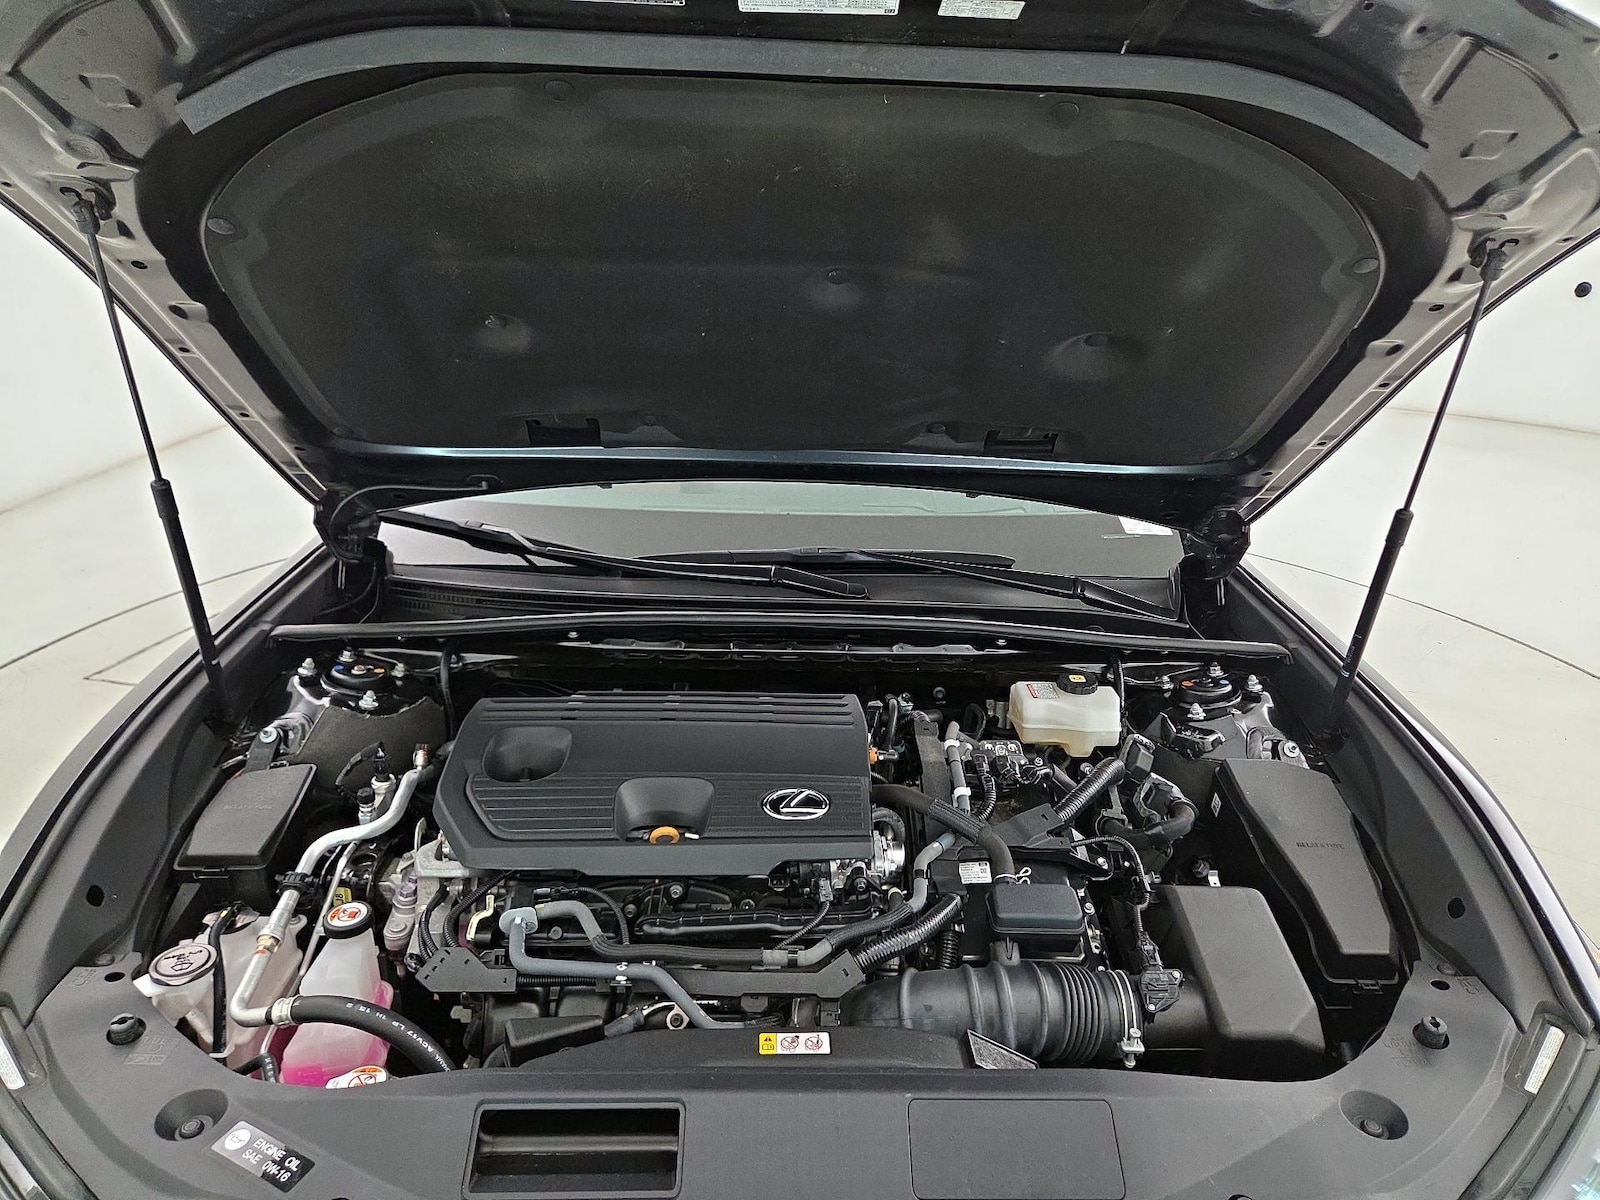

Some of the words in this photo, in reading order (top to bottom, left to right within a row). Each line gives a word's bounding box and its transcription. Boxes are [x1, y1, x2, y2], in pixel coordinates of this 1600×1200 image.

[242, 1149, 263, 1165] SAE
[261, 1160, 292, 1182] 0W-16
[253, 1138, 287, 1161] ENGINE
[284, 1156, 301, 1171] OIL
